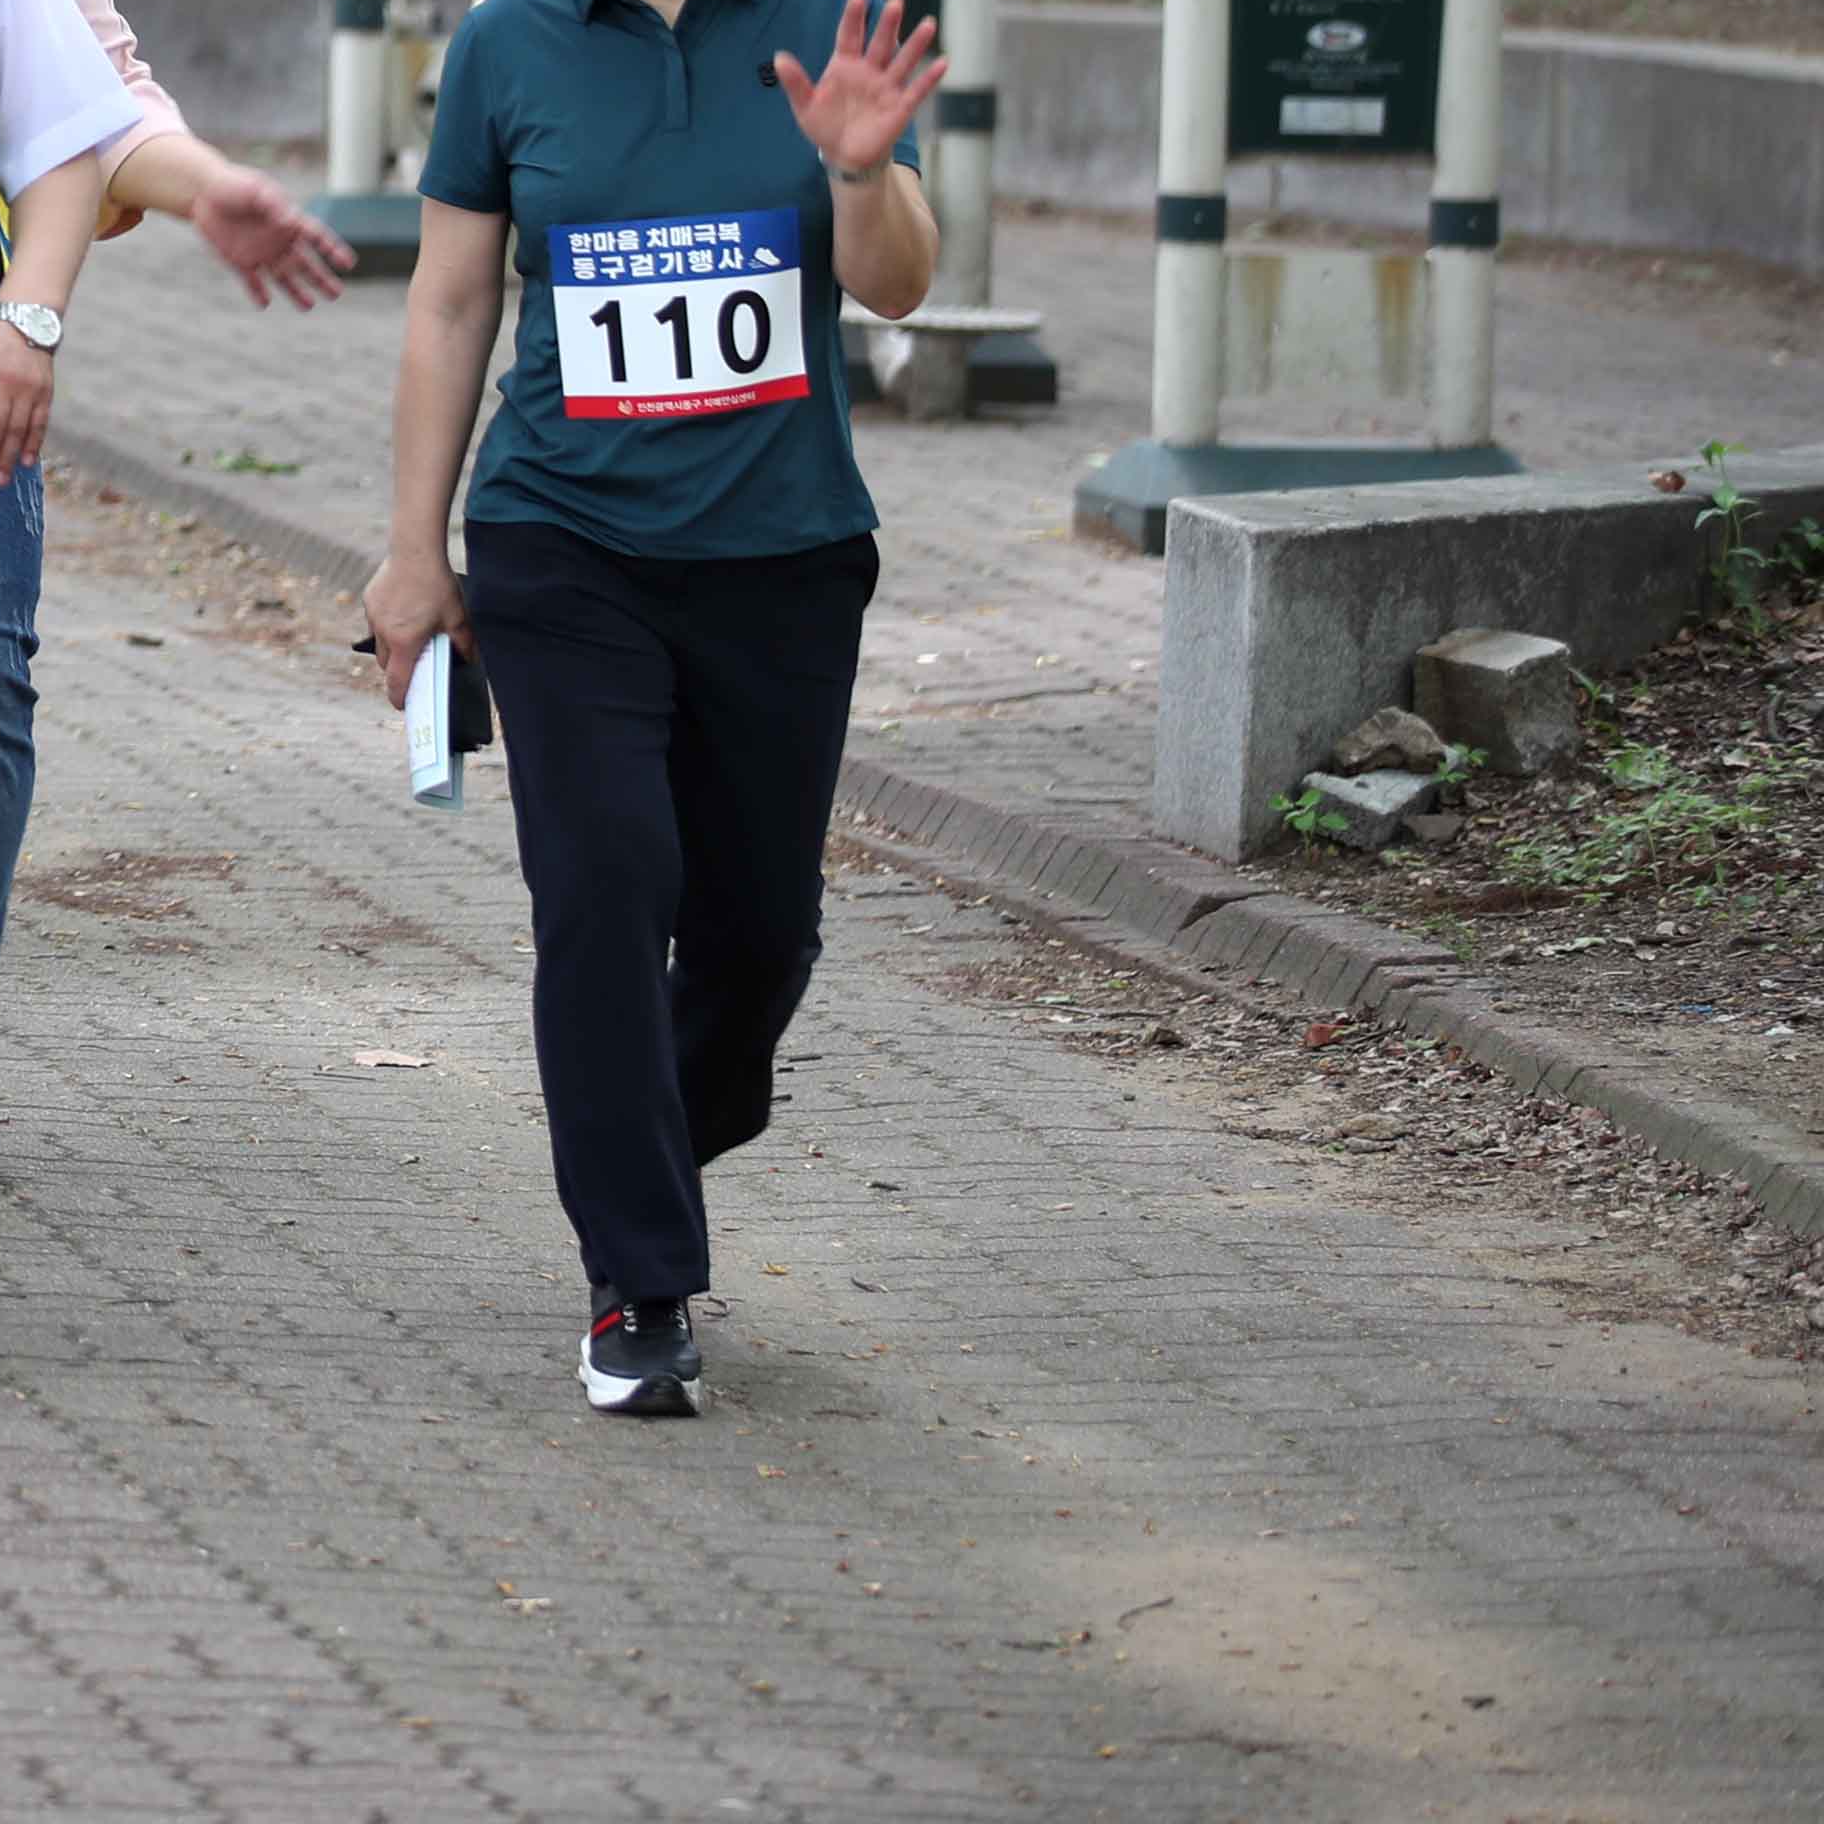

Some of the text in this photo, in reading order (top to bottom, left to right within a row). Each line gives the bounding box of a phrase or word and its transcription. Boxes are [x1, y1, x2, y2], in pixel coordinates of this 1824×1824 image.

[567, 222, 743, 254] 한마음 치매극복
[588, 288, 772, 383] 110
